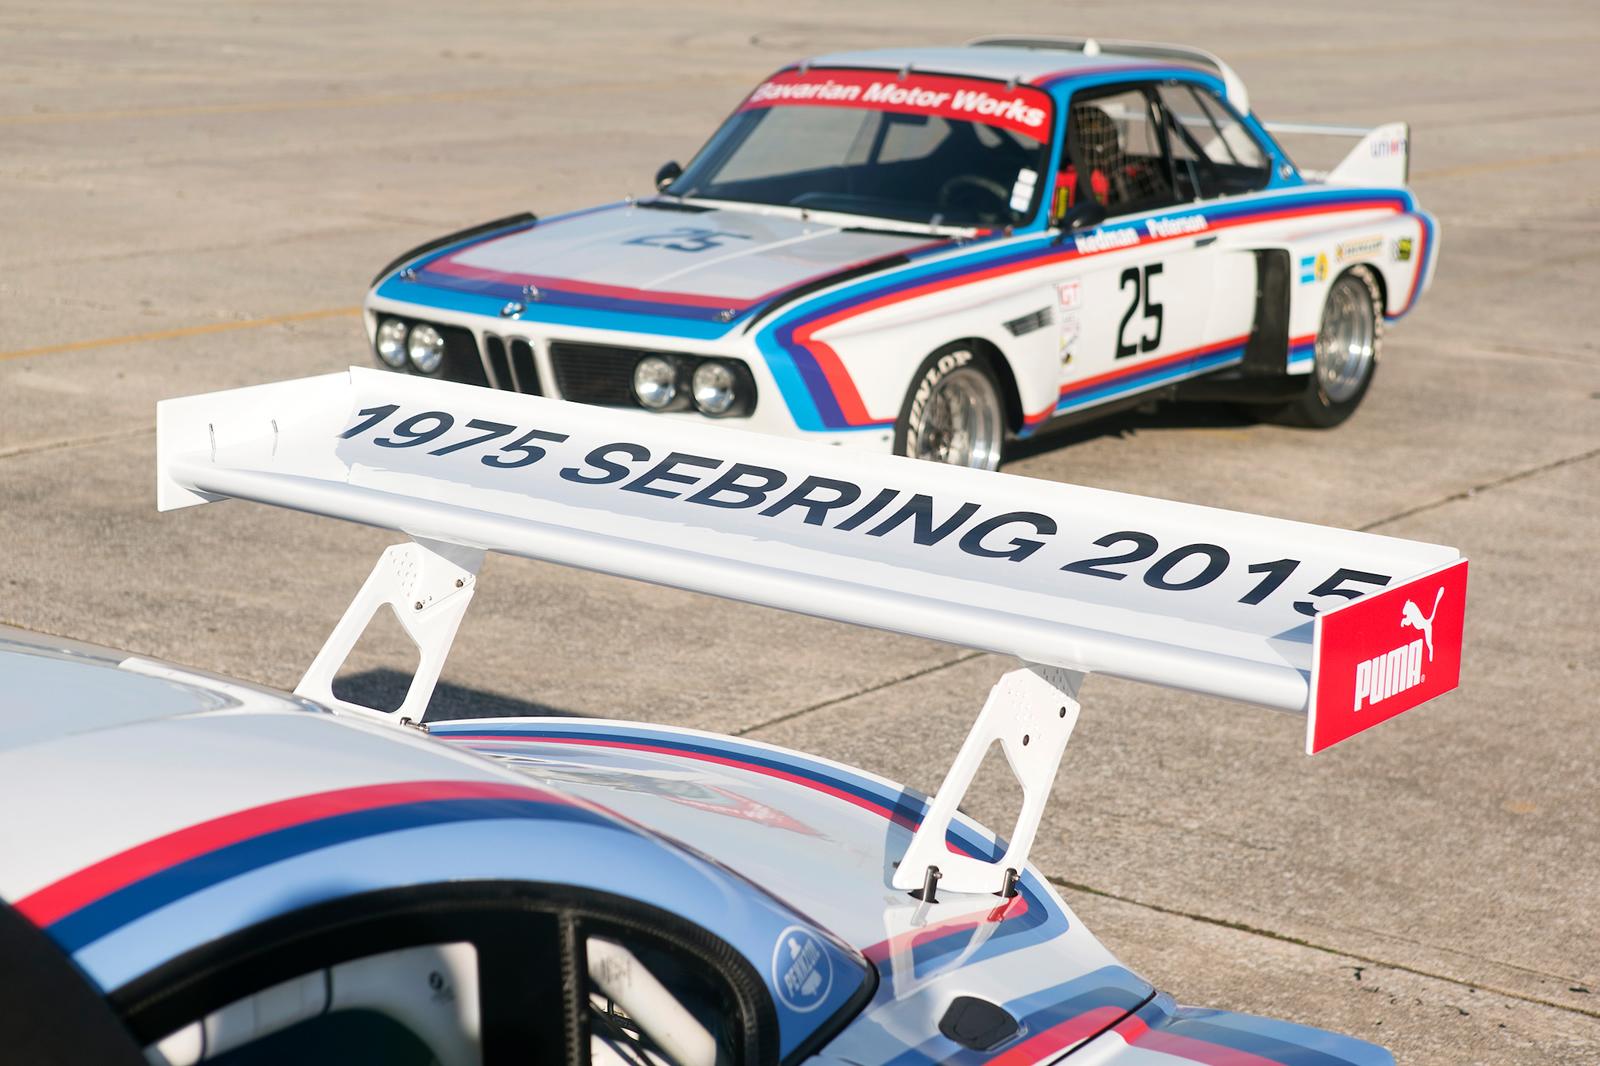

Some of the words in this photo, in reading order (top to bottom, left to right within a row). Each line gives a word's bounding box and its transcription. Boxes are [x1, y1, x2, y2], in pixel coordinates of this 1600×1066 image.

[750, 81, 862, 102] Bavarian
[862, 82, 950, 109] Motor
[951, 89, 1047, 128] Works
[1114, 262, 1164, 360] 25
[339, 403, 570, 469] 1975
[559, 442, 1058, 563] SEBRING
[1059, 530, 1393, 618] 2015
[1353, 638, 1424, 713] PUMA
